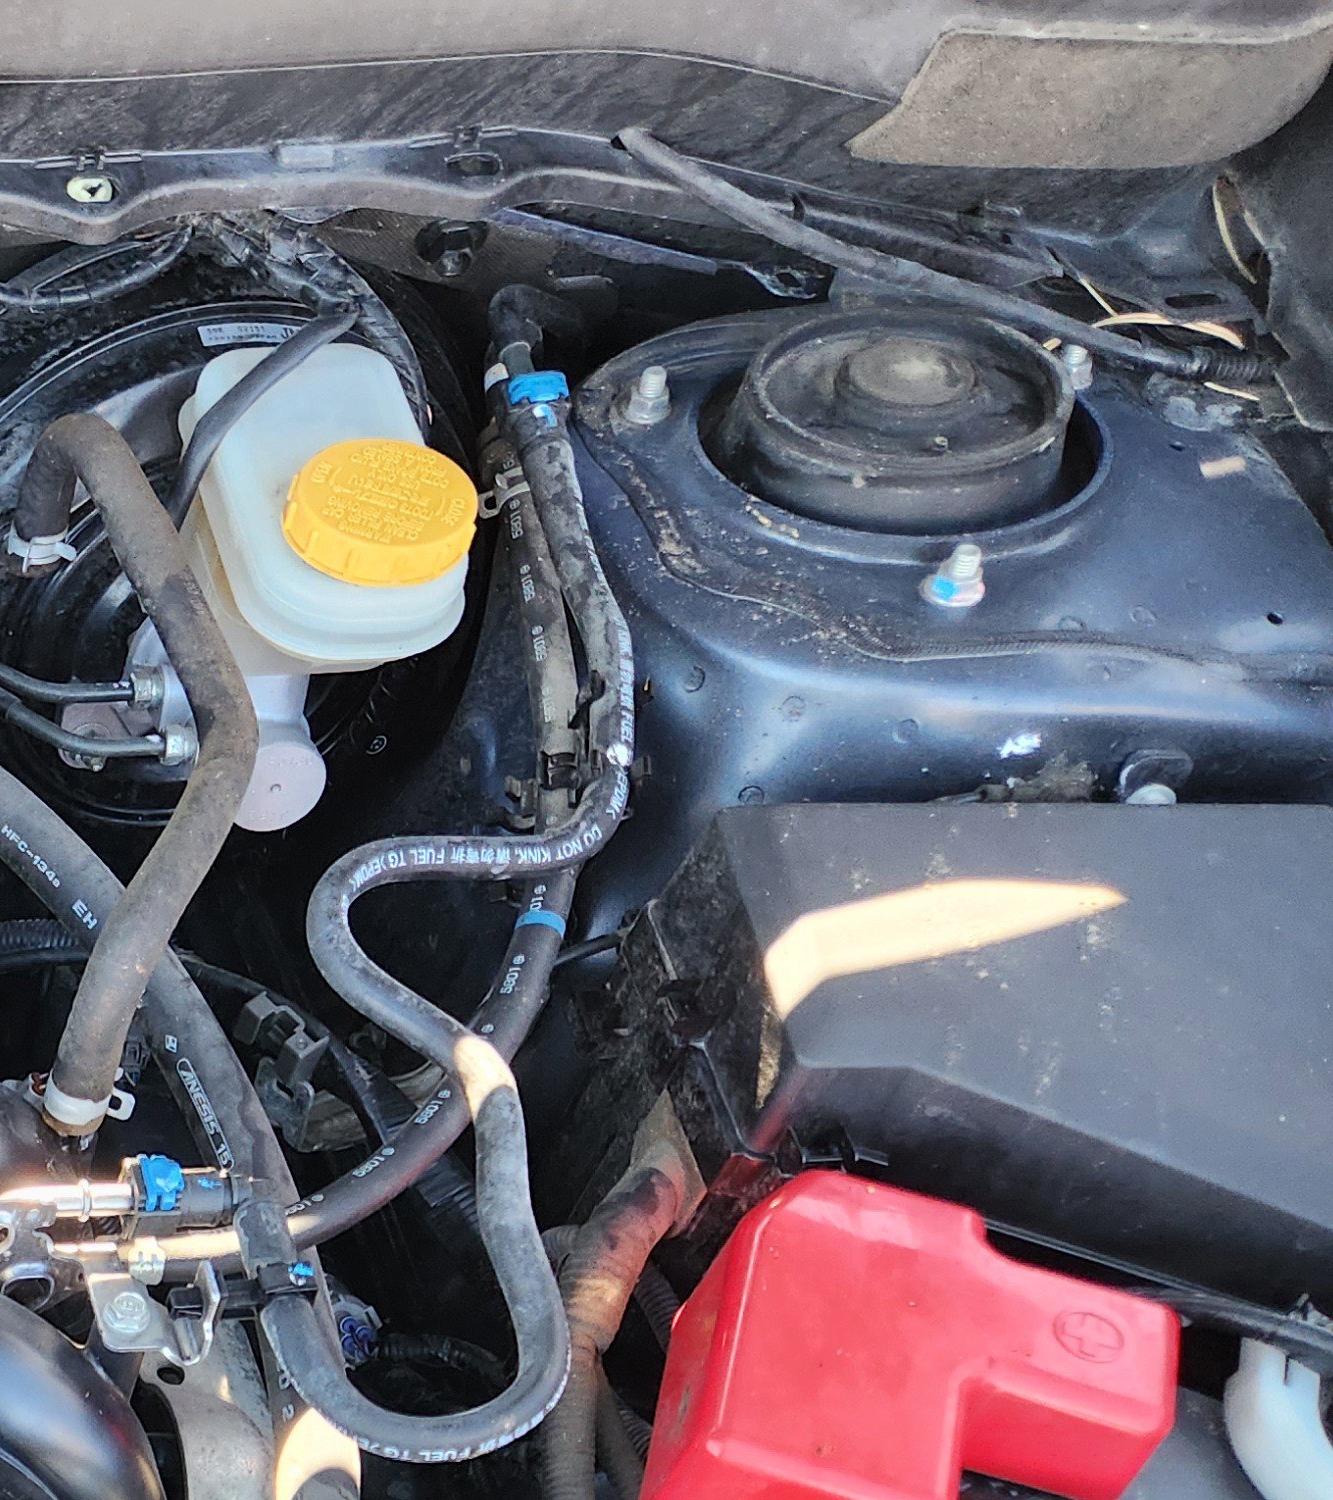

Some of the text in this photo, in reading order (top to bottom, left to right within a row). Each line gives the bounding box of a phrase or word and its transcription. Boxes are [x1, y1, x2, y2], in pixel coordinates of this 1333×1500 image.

[351, 452, 379, 467] FLUID
[363, 446, 400, 462] SEALED
[368, 467, 419, 489] USE ONLY
[417, 461, 445, 476] FROM
[327, 496, 380, 517] REMOVING
[440, 496, 465, 525] CLOSE
[322, 504, 417, 539] CLEAN FILLER CAP
[384, 513, 423, 530] BEFORE
[583, 824, 602, 847] DO
[387, 848, 404, 864] TG
[408, 845, 444, 863] FUEL
[555, 838, 580, 860] NOT
[0, 824, 62, 888] HFC-134a
[70, 898, 99, 931] EH
[214, 1140, 231, 1167] 15
[417, 1446, 469, 1461] FUEL
